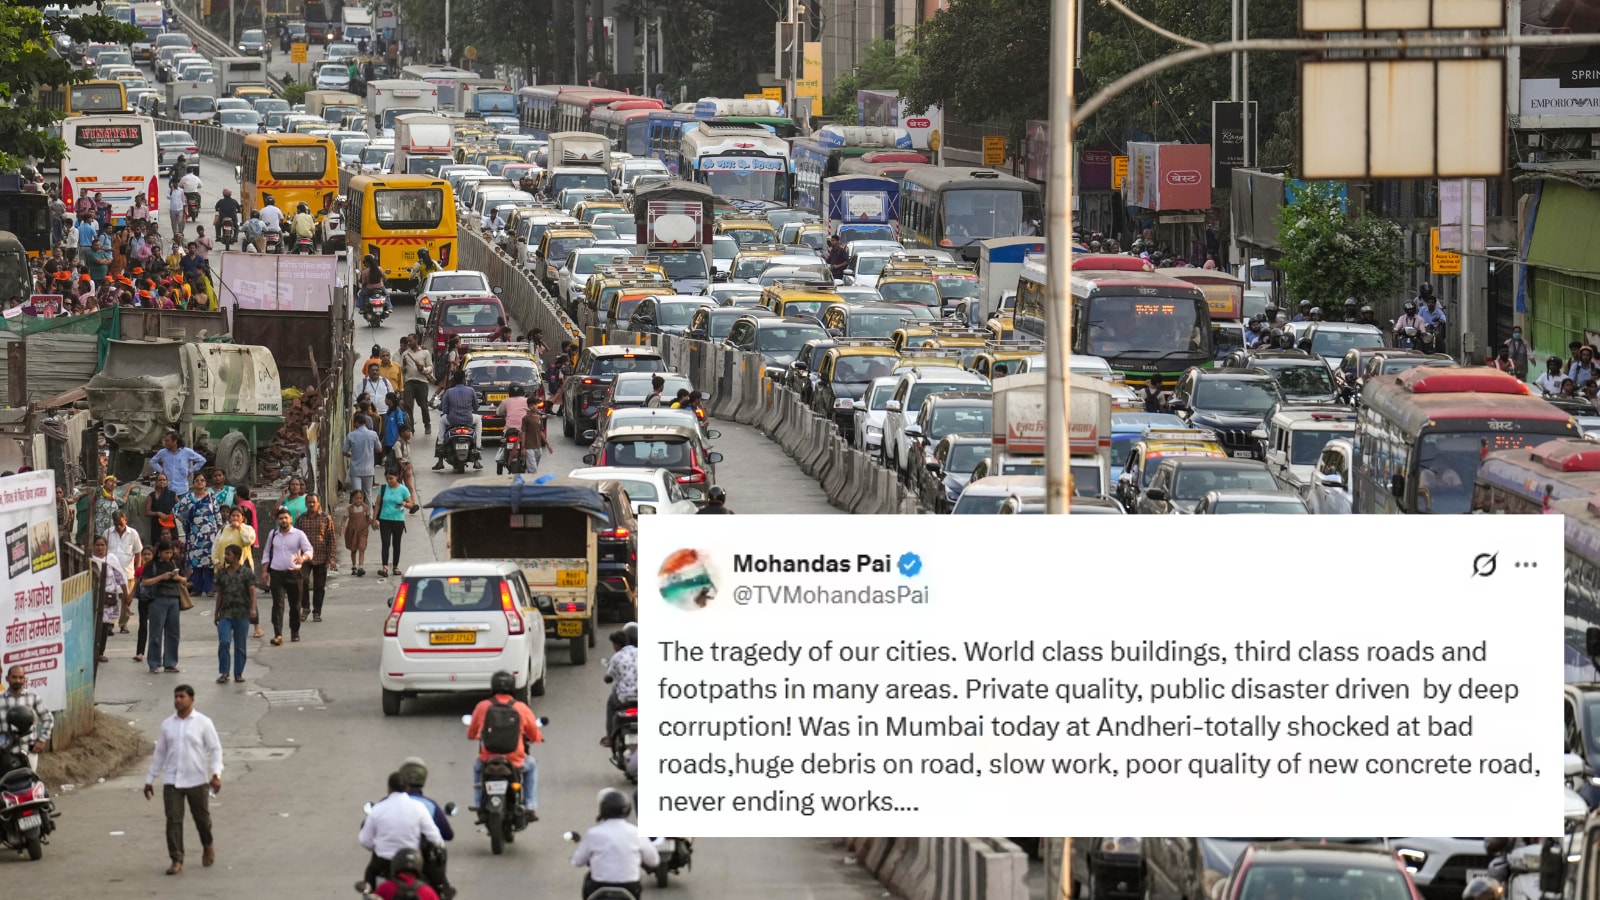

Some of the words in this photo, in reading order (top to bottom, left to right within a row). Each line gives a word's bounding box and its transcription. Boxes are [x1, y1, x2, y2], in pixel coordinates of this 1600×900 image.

[1531, 98, 1574, 108] EMPORIO
[82, 128, 138, 139] VINAYAK
[1171, 173, 1197, 184] बेस्ट
[258, 403, 278, 411] SCHWING
[1487, 418, 1513, 430] बेस्ट
[14, 580, 54, 612] जन-आक्रोश
[5, 617, 28, 646] महिला
[28, 613, 62, 640] सम्मेलन
